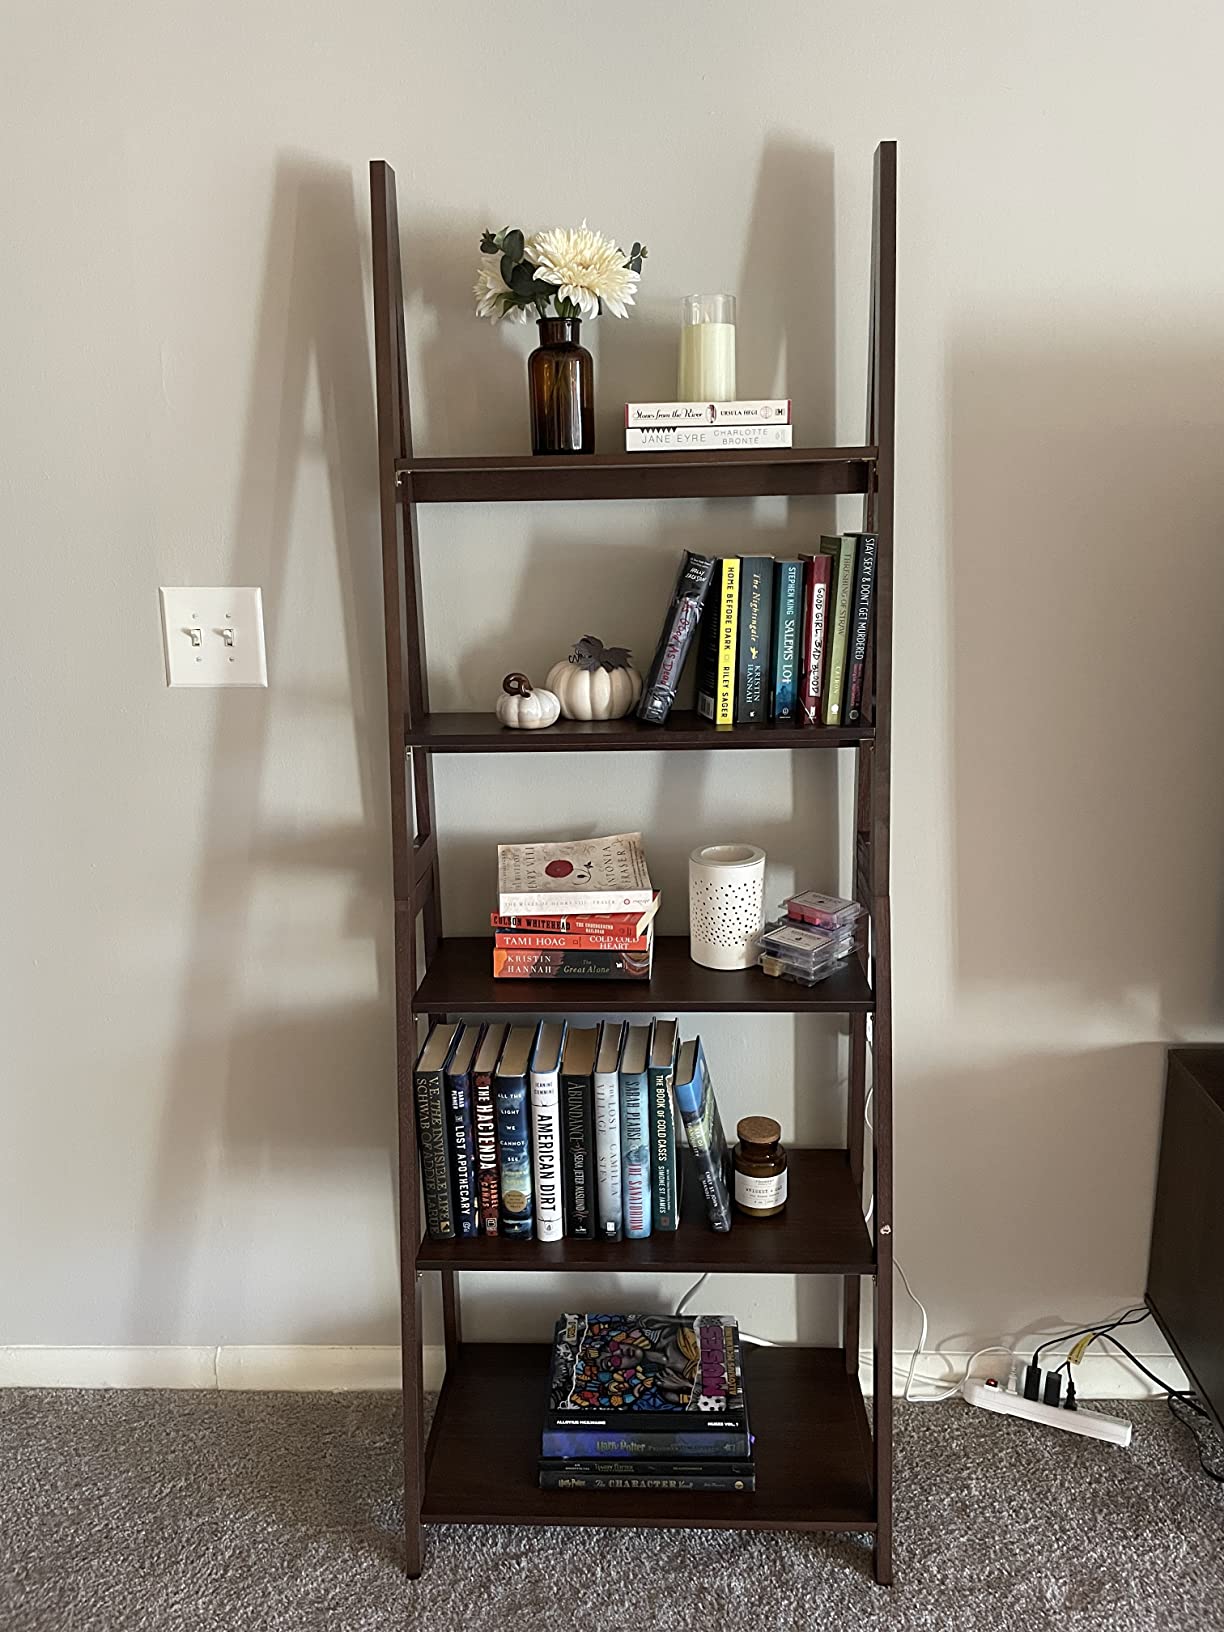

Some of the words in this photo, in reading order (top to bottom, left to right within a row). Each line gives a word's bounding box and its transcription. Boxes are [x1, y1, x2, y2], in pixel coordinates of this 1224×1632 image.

[656, 410, 670, 420] from
[672, 410, 682, 418] the
[683, 408, 703, 418] River
[642, 435, 670, 444] JANE
[677, 434, 706, 443] EYRE
[865, 538, 875, 554] STAY
[842, 554, 852, 599] THRESHING
[863, 556, 873, 578] SEXY
[752, 574, 761, 588] The
[788, 567, 796, 599] STEPHEN
[725, 594, 733, 624] BEFORE
[786, 600, 794, 615] KING
[816, 587, 826, 610] GOOD
[840, 600, 847, 611] OF
[748, 590, 760, 642] Nightingale
[838, 612, 846, 636] STRAW
[858, 609, 868, 622] GET
[672, 619, 690, 644] Good
[724, 628, 732, 650] DARK
[856, 623, 867, 660] MURDERED
[813, 640, 822, 660] BAD
[660, 659, 674, 686] Dead
[722, 666, 730, 688] RILEY
[812, 664, 820, 694] BLOOD
[720, 692, 729, 718] SAGER
[525, 847, 535, 866] VIII
[602, 846, 616, 887] ANTONIA
[616, 850, 632, 884] FRASER
[526, 870, 538, 889] ENRY
[494, 916, 522, 926] COLSON
[526, 918, 571, 930] WHITEHEAD
[585, 922, 614, 930] UNDERGROUND
[504, 937, 532, 946] TAMI
[536, 937, 566, 946] HOAG
[590, 935, 614, 943] COLD
[508, 955, 551, 963] KRISTIN
[428, 1077, 439, 1087] V.
[656, 1075, 664, 1086] THE
[417, 1078, 430, 1130] SCHWAB
[430, 1088, 440, 1099] E.
[478, 1086, 490, 1101] THE
[626, 1082, 640, 1108] SARAH
[656, 1088, 666, 1108] BOOK
[431, 1100, 441, 1125] THE
[568, 1082, 586, 1142] ABUNDANCE
[596, 1084, 606, 1136] VILLAGE
[608, 1102, 618, 1132] LOST
[657, 1110, 665, 1118] OF
[455, 1125, 466, 1149] LOST
[477, 1104, 496, 1170] HACIENDA
[627, 1112, 641, 1141] PEARSE
[657, 1119, 666, 1138] COLD
[433, 1127, 447, 1190] INVISIBLE
[537, 1114, 554, 1179] AMERICAN
[658, 1139, 667, 1161] CASES
[423, 1150, 436, 1190] ADDIE
[574, 1169, 585, 1184] JETER
[599, 1156, 607, 1183] STEN
[609, 1143, 618, 1196] CAMILLA
[628, 1162, 641, 1176] THE
[457, 1154, 470, 1214] APOTHECARY
[490, 1180, 499, 1208] ISABEL
[439, 1192, 450, 1219] LIFE
[540, 1185, 556, 1211] DIRT
[575, 1186, 586, 1210] NASLUND
[628, 1180, 643, 1231] SANATORIUM
[709, 1193, 718, 1207] JOHN
[427, 1193, 440, 1233] LARUE
[700, 1326, 728, 1396] MUSES
[596, 1440, 620, 1451] Harry
[620, 1440, 646, 1452] Potter
[608, 1480, 679, 1488] CHARACTER
